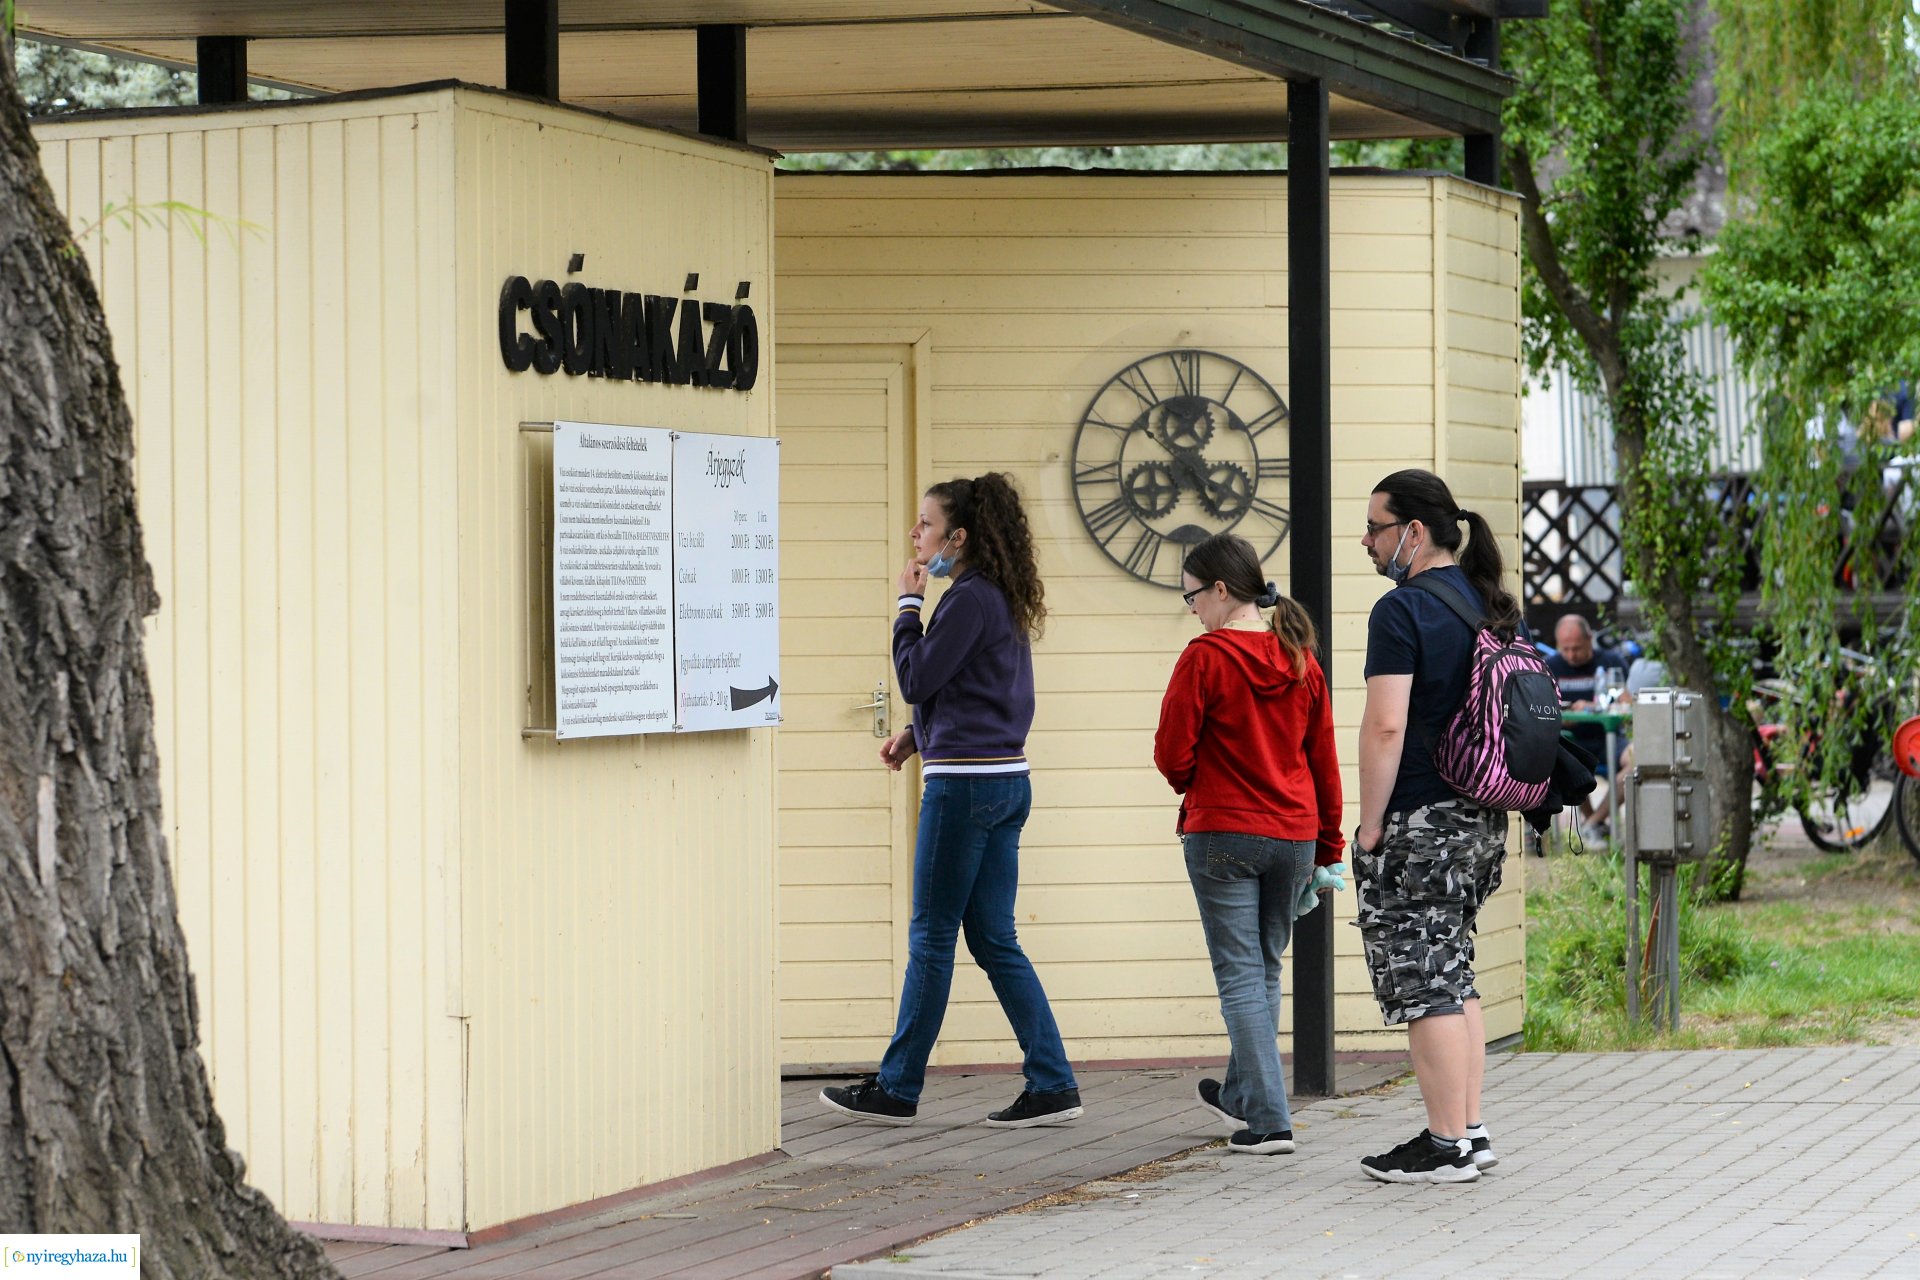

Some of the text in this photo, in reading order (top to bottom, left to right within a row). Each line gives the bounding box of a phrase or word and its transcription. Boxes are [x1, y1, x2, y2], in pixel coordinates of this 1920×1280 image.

[499, 253, 759, 391] CSÓNAKÁZÓ
[705, 443, 747, 488] Árjegyzék
[731, 534, 744, 549] 2000
[744, 534, 750, 549] Ft
[755, 534, 768, 550] 2500
[768, 534, 774, 549] Ft
[678, 567, 774, 584] Csónak 1000 Ft 1300 Ft
[679, 603, 706, 619] Elektromos
[731, 603, 744, 619] 3500
[744, 603, 750, 618] Ft
[768, 603, 774, 617] Ft
[709, 692, 714, 706] 9
[1529, 703, 1558, 715] AVON
